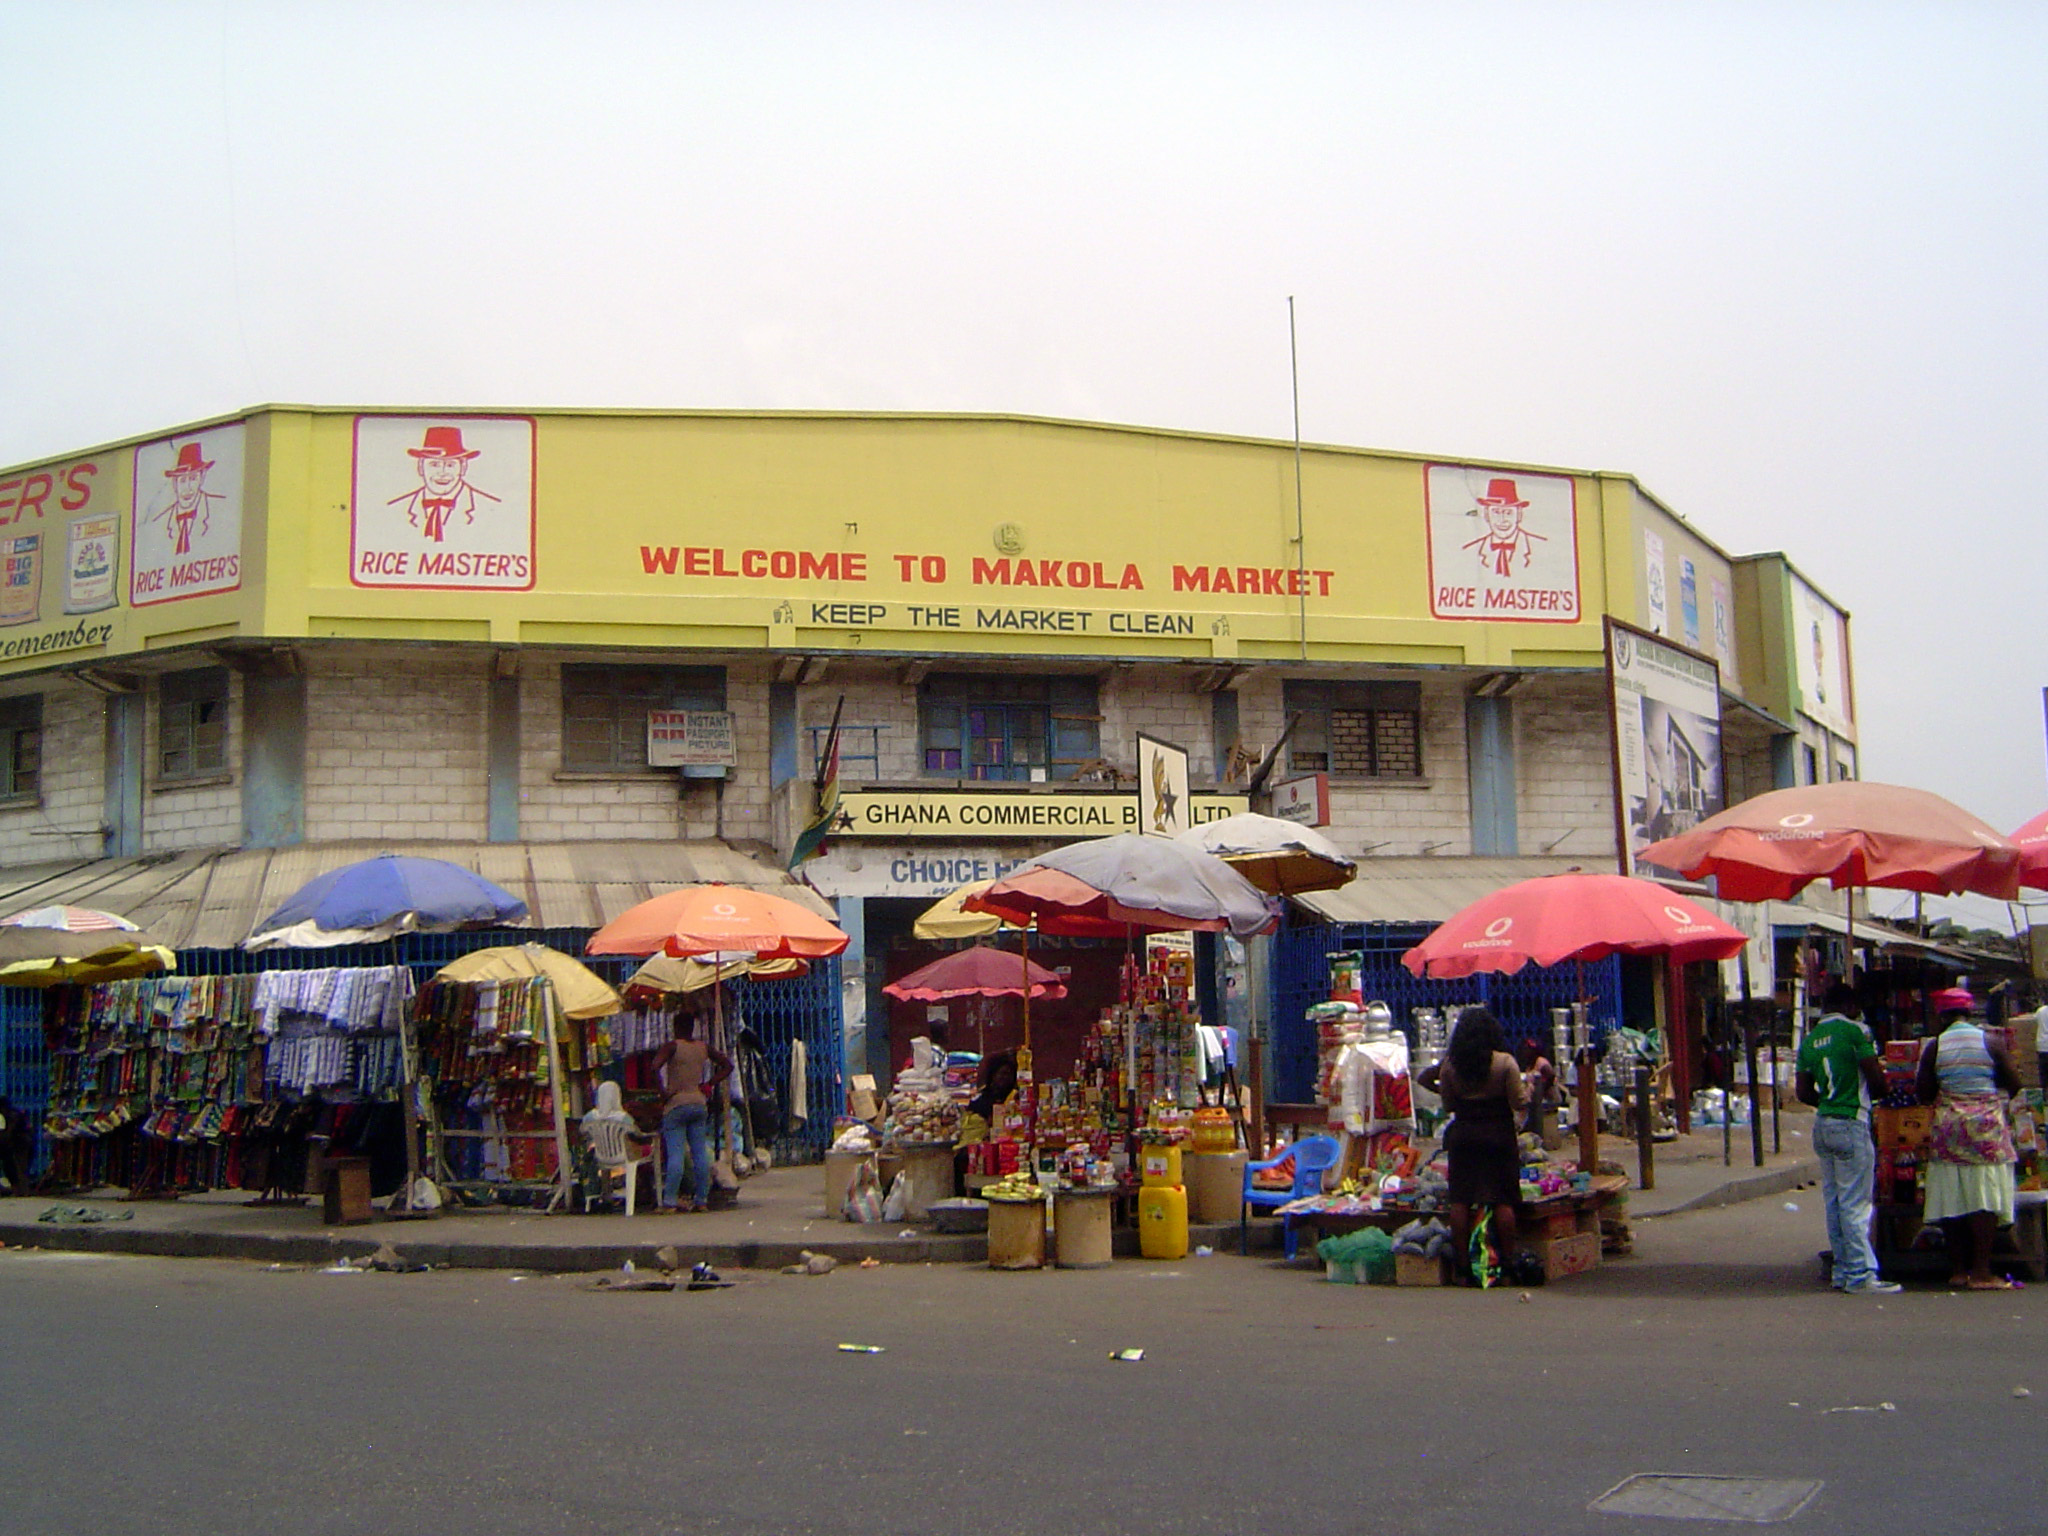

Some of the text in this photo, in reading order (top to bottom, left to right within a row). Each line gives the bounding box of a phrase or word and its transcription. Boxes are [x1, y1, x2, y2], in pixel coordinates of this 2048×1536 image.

[6, 556, 32, 571] BIG
[135, 554, 239, 594] RICE MASTER'S
[361, 551, 528, 578] RICE MASTER'S
[640, 546, 1335, 596] WELCOME TO MAKOLA MARKET
[5, 570, 31, 588] JOE
[1438, 586, 1573, 612] RICE MASTER'S
[811, 603, 1194, 634] KEEP THE MARKET CLEAN
[687, 715, 729, 728] INSTANT
[865, 804, 952, 826] GHANA
[959, 805, 1117, 826] COMMERCIAL
[1193, 806, 1231, 824] LTD
[1758, 830, 1824, 842] vodafone
[890, 859, 988, 883] CHOICE
